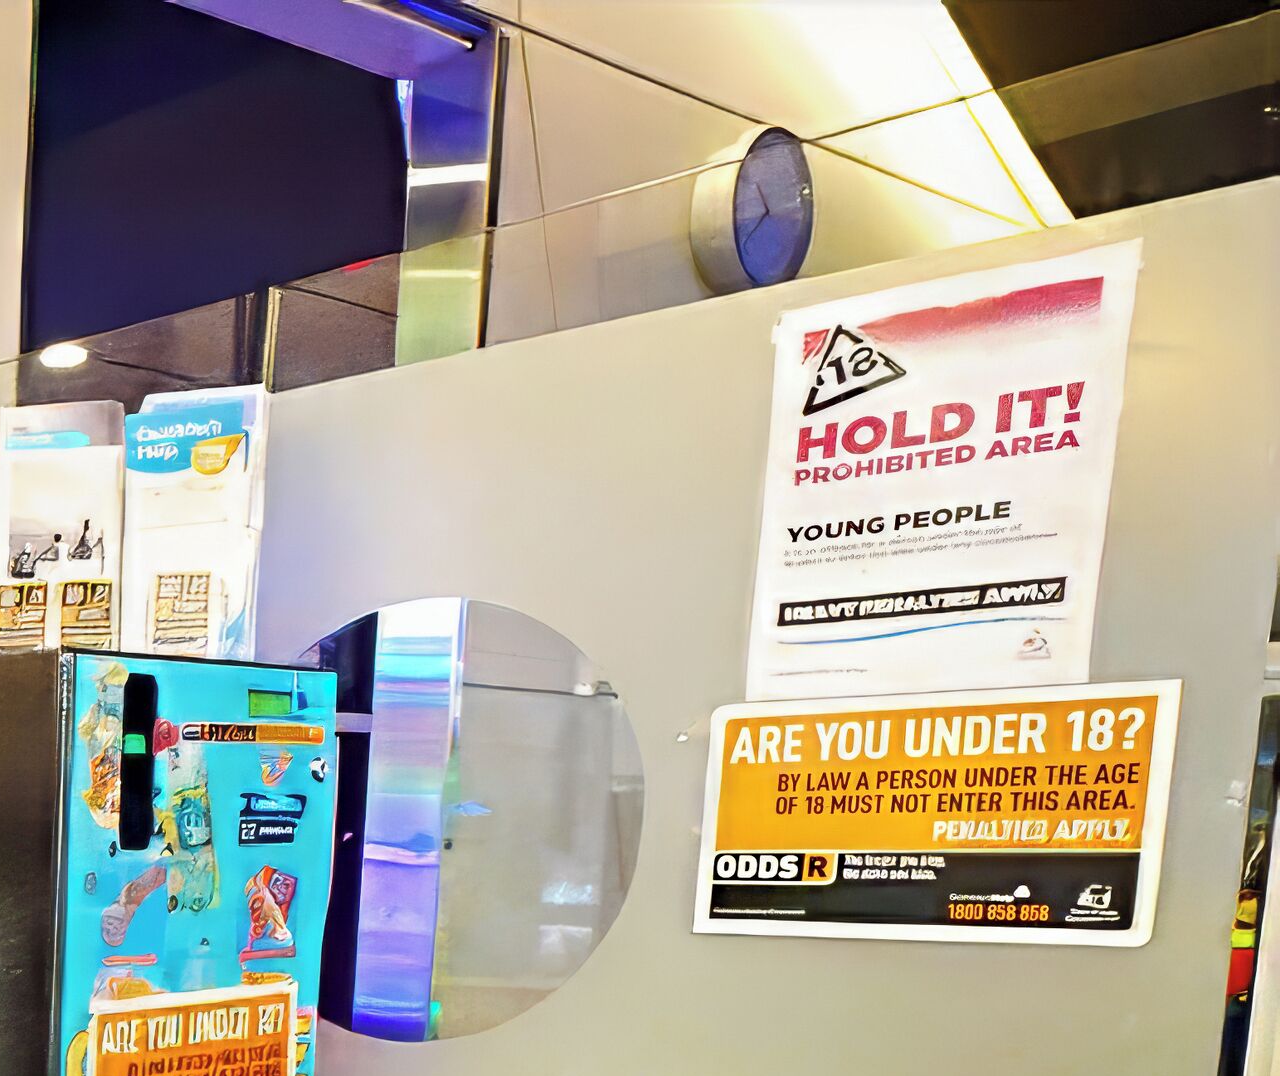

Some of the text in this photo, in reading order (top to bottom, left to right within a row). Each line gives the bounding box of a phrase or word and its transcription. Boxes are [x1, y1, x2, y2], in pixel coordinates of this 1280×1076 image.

[796, 380, 1086, 464] HOLD IT!
[793, 429, 1081, 487] PROHIBITED AREA
[786, 500, 1012, 544] YOUNG PEOPLE
[729, 706, 1146, 765] ARE YOU UNDER 18?
[777, 762, 1141, 792] BY LAW A PERSON UNDER THE AGE
[775, 788, 1137, 815] OF 18 MUST NOT ENTER THIS AREA.
[716, 854, 800, 879] ODDS
[807, 855, 828, 878] R
[947, 902, 984, 921] 1800
[986, 902, 1017, 922] 858
